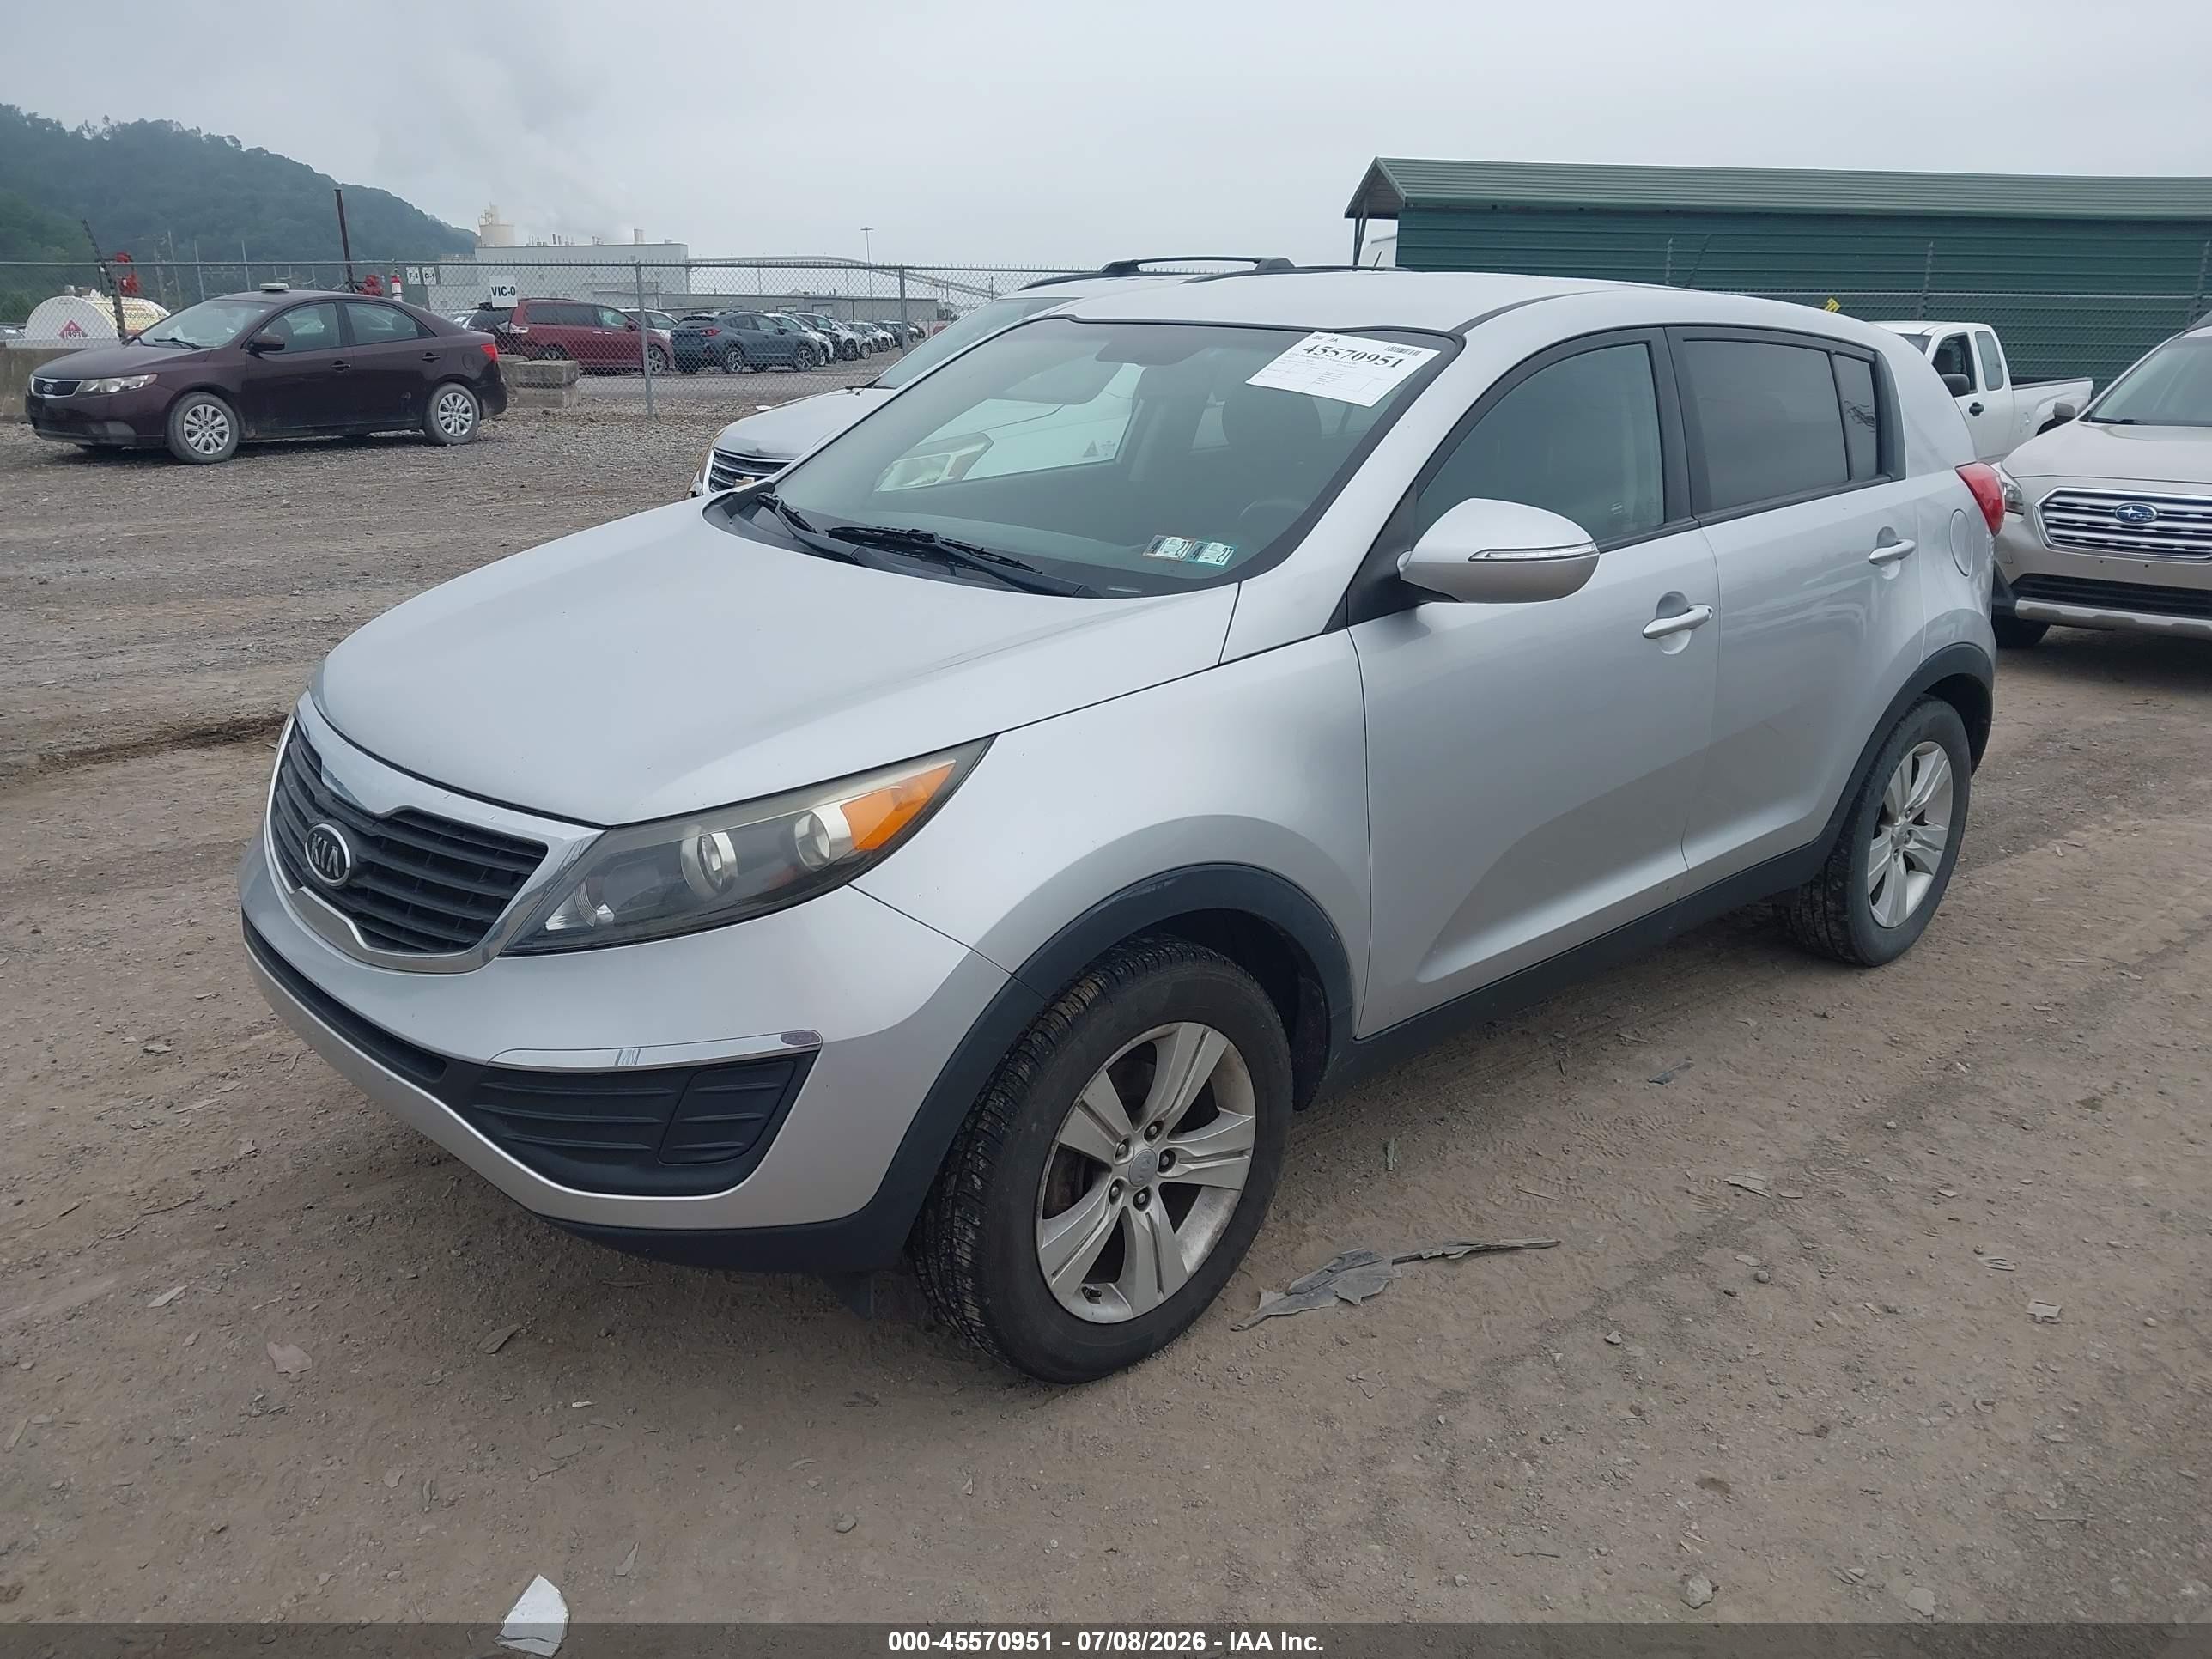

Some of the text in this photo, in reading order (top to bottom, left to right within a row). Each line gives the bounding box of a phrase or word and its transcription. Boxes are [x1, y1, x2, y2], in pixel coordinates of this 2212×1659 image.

[491, 285, 516, 296] VIC-0
[1304, 344, 1406, 368] 45570951
[310, 832, 340, 878] KIA
